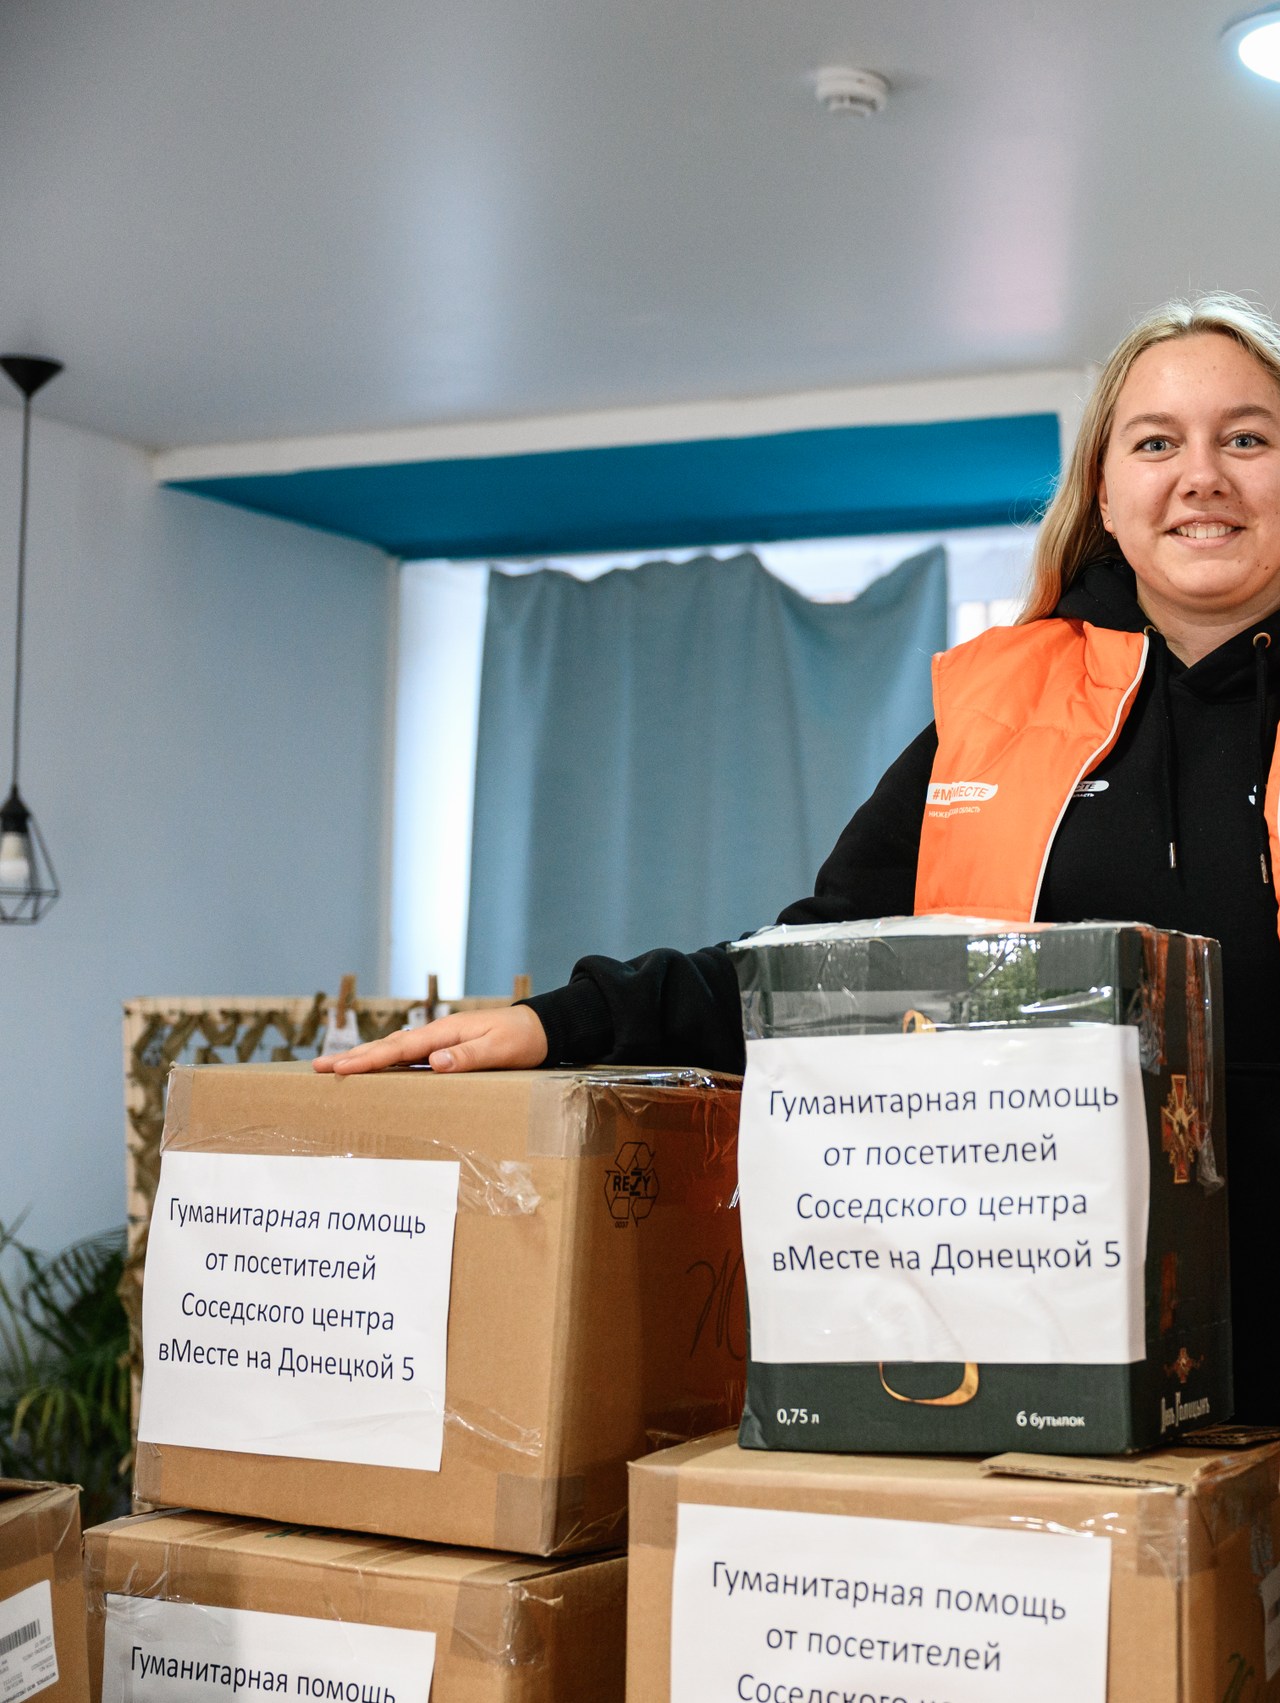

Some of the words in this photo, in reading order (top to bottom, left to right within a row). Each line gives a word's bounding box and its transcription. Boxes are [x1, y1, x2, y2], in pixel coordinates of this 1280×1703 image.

[770, 1090, 977, 1123] Гуманитарная
[989, 1086, 1119, 1113] помощь
[823, 1146, 857, 1167] от
[866, 1133, 1057, 1166] посетителей
[170, 1197, 321, 1233] Гуманитарная
[327, 1211, 426, 1240] помощь
[796, 1192, 967, 1224] Соседского
[978, 1194, 1087, 1222] центра
[205, 1252, 229, 1271] от
[233, 1254, 376, 1281] посетителей
[772, 1244, 880, 1272] вМесте
[888, 1249, 921, 1271] на
[930, 1239, 1092, 1277] Донецкой
[1104, 1240, 1121, 1268] 5
[181, 1292, 305, 1327] Соседского
[312, 1307, 395, 1336] центра
[158, 1337, 239, 1367] вМесте
[246, 1349, 271, 1370] на
[277, 1346, 394, 1383] Донецкой
[401, 1356, 415, 1382] 5
[776, 1408, 809, 1426] 0,75
[811, 1413, 820, 1424] л
[1016, 1410, 1028, 1427] 6
[1029, 1412, 1086, 1430] бутылок
[712, 1560, 924, 1609] Гуманитарная
[935, 1588, 1067, 1625] помощь
[766, 1628, 799, 1651] от
[807, 1632, 1001, 1672] посетителей
[131, 1645, 288, 1694] Гуманитарная
